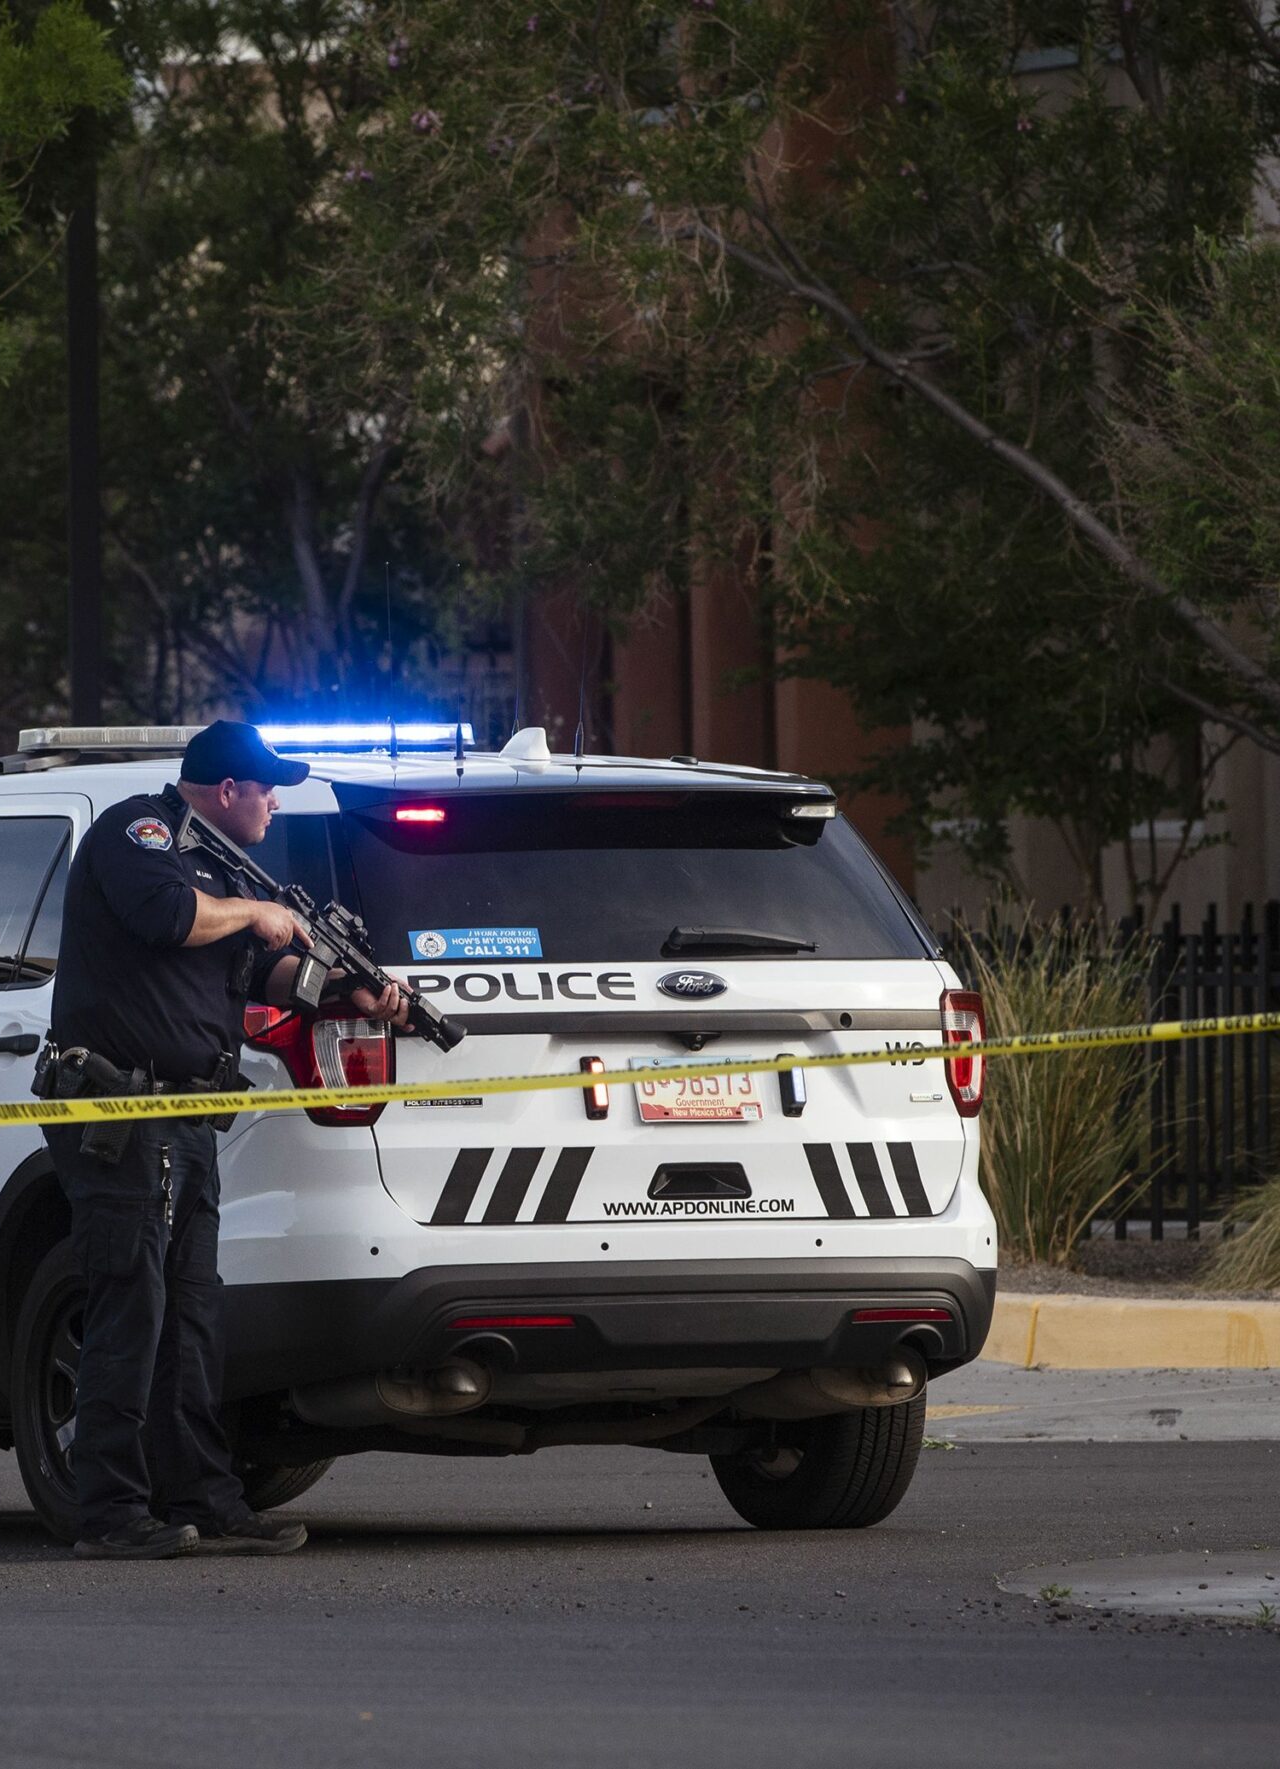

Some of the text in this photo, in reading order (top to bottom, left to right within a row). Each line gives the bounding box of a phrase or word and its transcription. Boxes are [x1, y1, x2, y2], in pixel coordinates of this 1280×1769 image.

[497, 937, 537, 945] DRIVING?
[464, 945, 530, 956] CALL 311
[407, 972, 636, 1003] POLICE
[675, 974, 715, 993] Ford
[675, 1098, 725, 1107] Government
[672, 1107, 733, 1117] New Mexico USA
[603, 1198, 795, 1216] WWW.APDONLINE.COM
